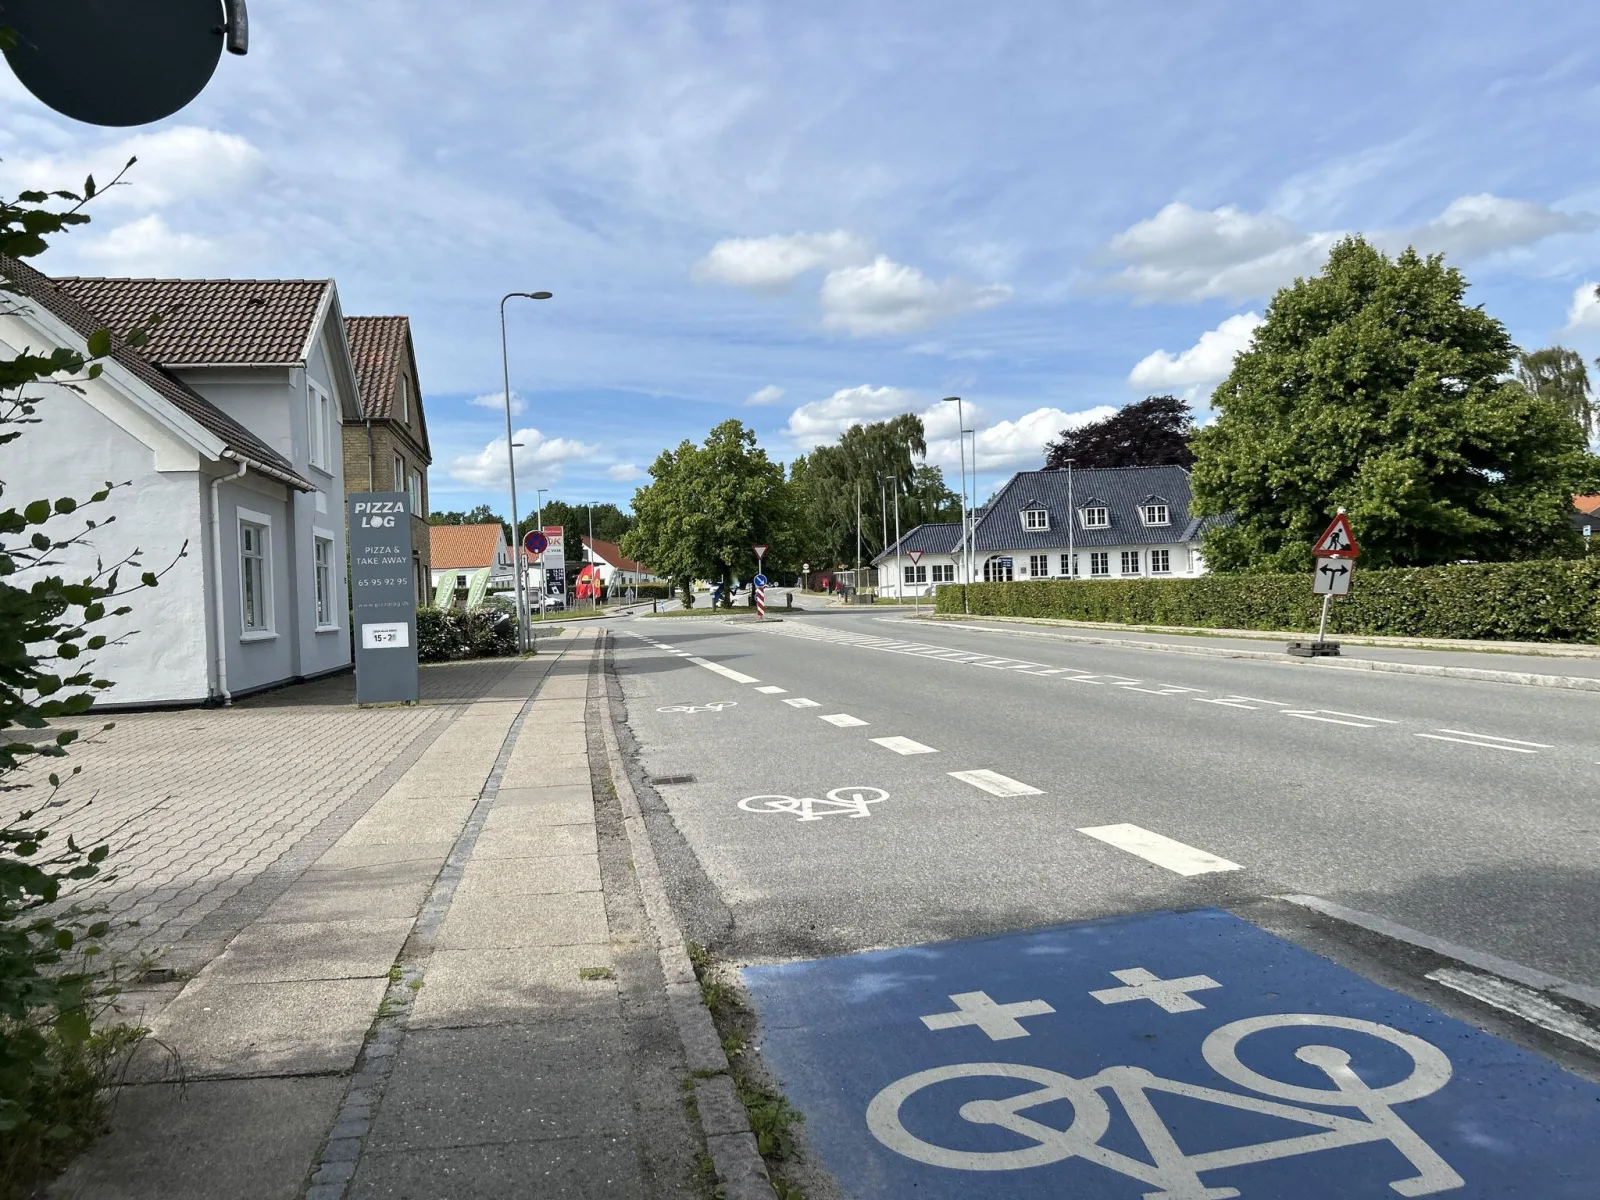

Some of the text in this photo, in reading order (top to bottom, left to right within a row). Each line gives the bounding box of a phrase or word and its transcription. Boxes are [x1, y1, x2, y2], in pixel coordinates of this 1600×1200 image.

[354, 501, 405, 514] PIZZA
[361, 515, 395, 528] LOG
[364, 545, 400, 554] PIZZA &
[356, 556, 407, 565] TAKE AWAY
[358, 577, 408, 587] 65 95 92 95
[374, 634, 382, 642] 15
